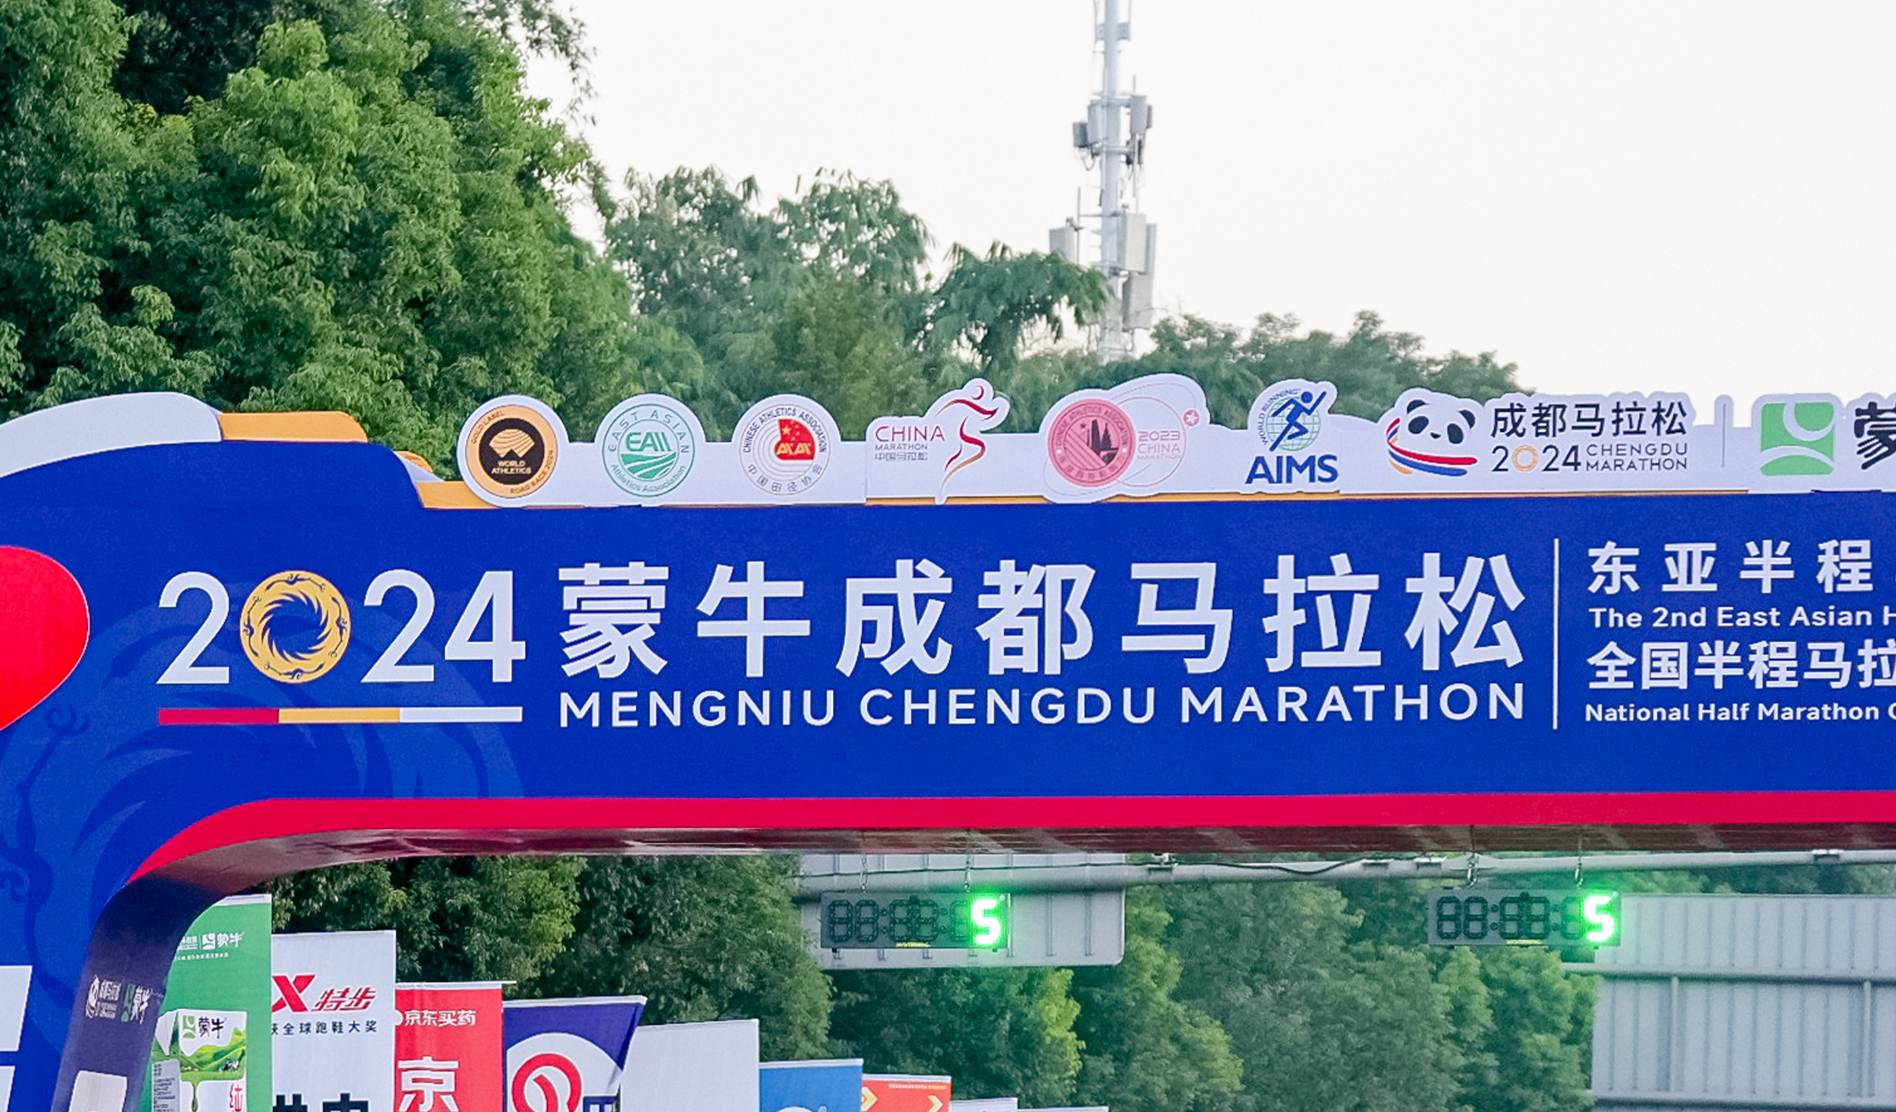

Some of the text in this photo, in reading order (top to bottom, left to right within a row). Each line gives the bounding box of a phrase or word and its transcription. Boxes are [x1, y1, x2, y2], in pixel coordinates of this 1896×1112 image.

[608, 410, 690, 453] EAST ASIAN
[875, 425, 945, 441] CHINA
[1490, 401, 1687, 438] 成都马拉松
[874, 443, 928, 451] MARATHON
[1137, 443, 1181, 454] CHINA
[1138, 431, 1180, 441] 2023
[1491, 445, 1582, 472] 2024
[1586, 443, 1688, 457] CHENGDU
[1245, 454, 1338, 484] AIMS
[1586, 457, 1688, 472] MARATHON
[156, 568, 526, 684] 2024
[559, 552, 1526, 678] 蒙牛成都马拉松
[1589, 607, 1643, 628] The
[1652, 607, 1707, 628] 2nd
[1717, 607, 1781, 627] East
[1789, 606, 1873, 627] Asian
[1587, 639, 1896, 690] 全国半程马拉
[560, 683, 1524, 727] MENGNIU CHENGDU MARATHON
[1586, 702, 1879, 723] National Half Marathon
[972, 898, 1001, 945] 5
[1583, 895, 1615, 942] 5
[404, 1009, 477, 1027] 京东买药
